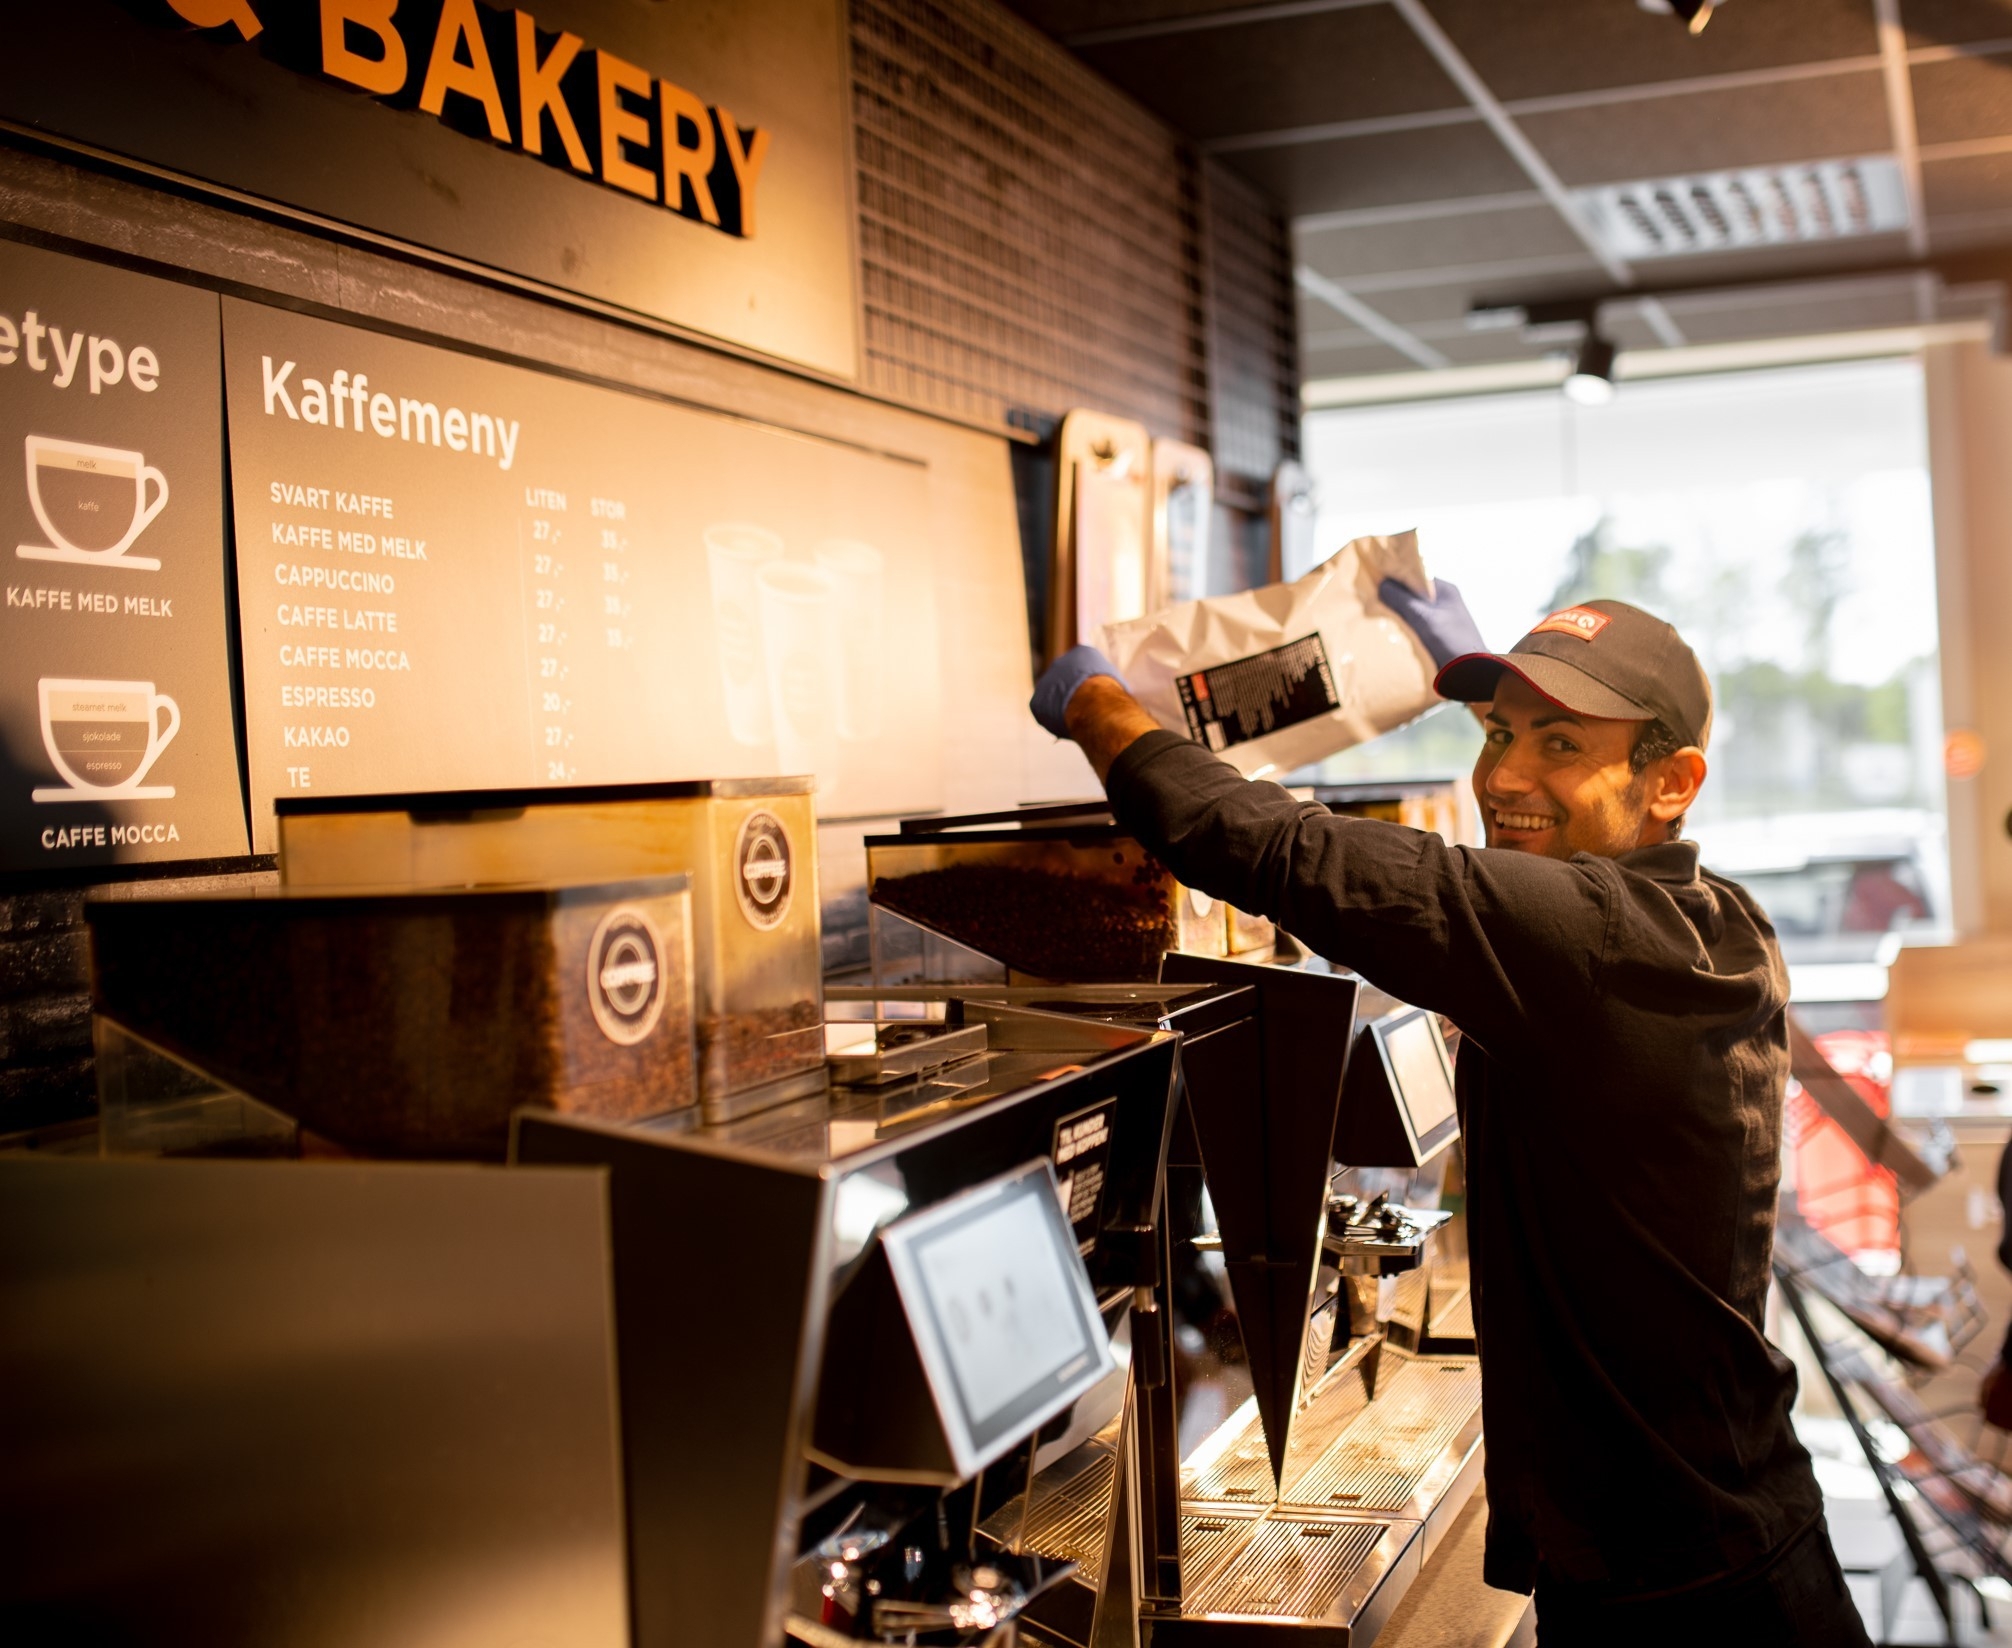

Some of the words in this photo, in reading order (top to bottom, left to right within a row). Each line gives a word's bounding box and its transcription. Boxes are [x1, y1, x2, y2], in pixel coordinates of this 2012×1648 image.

[320, 0, 770, 238] BAKERY
[261, 355, 520, 471] Kaffemeny
[77, 458, 97, 469] melk
[78, 500, 99, 512] kaffe
[270, 481, 330, 510] SVART
[335, 491, 394, 519] KAFFE
[525, 486, 567, 512] LITEN
[590, 497, 626, 521] STOR
[272, 522, 333, 550] KAFFE
[338, 531, 376, 554] MED
[381, 536, 428, 560] MELK
[275, 563, 395, 594] CAPPUCCINO
[6, 586, 72, 610] KAFFE
[78, 592, 119, 613] MED
[124, 596, 173, 617] MELK
[277, 604, 338, 629] CAFFE
[343, 609, 398, 633] LATTE
[279, 645, 341, 669] CAFFE
[346, 648, 411, 671] MOCCA
[107, 702, 127, 713] melk
[281, 685, 376, 708] ESPRESSO
[82, 731, 121, 742] sjokolade
[284, 726, 350, 748] KAKAO
[86, 760, 122, 771] espresso
[287, 767, 311, 788] TE
[41, 825, 106, 849] CAFFE
[111, 824, 180, 845] MOCCA
